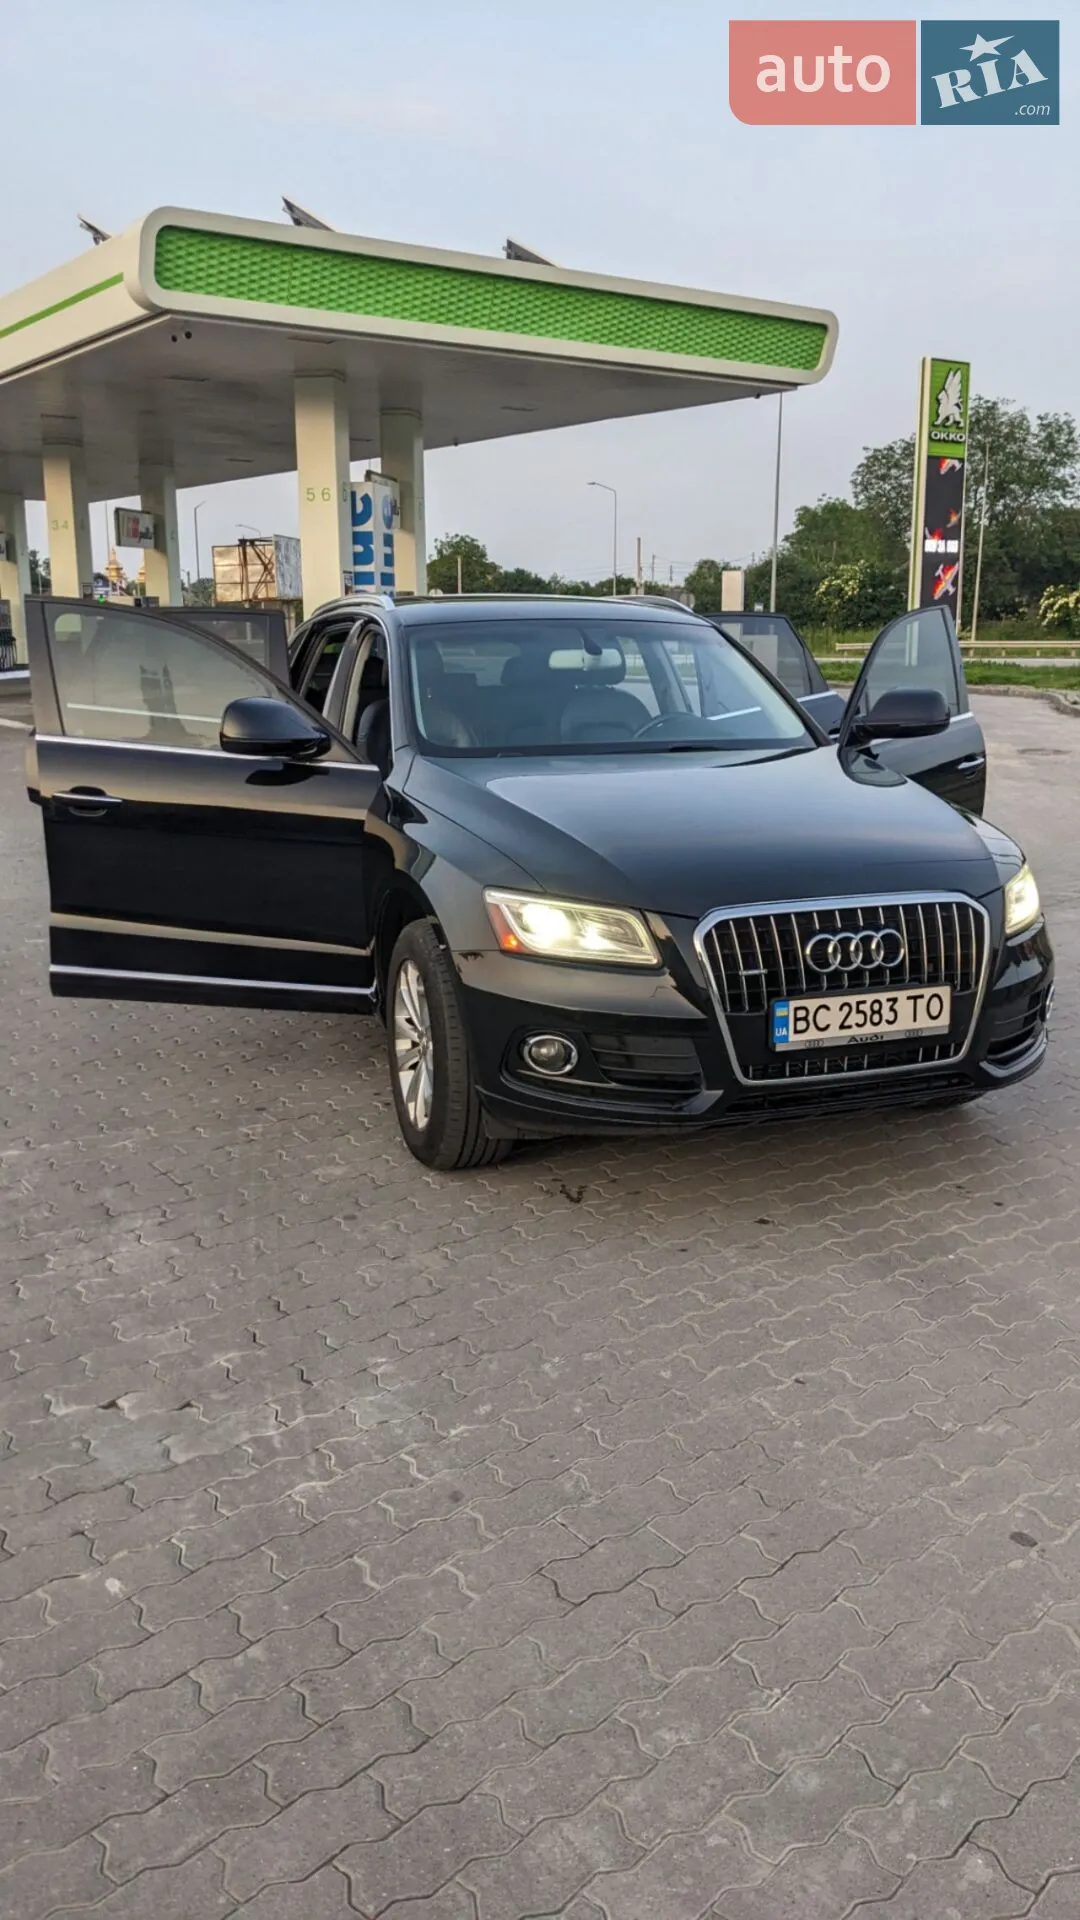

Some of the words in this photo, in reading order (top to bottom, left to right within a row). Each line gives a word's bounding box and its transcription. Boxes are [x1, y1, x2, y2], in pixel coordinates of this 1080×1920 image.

[931, 431, 966, 442] OKKO
[793, 1004, 831, 1035] BC
[838, 997, 898, 1030] 2583
[906, 993, 944, 1024] TO
[775, 1026, 788, 1037] UA
[846, 1034, 884, 1044] Audi
